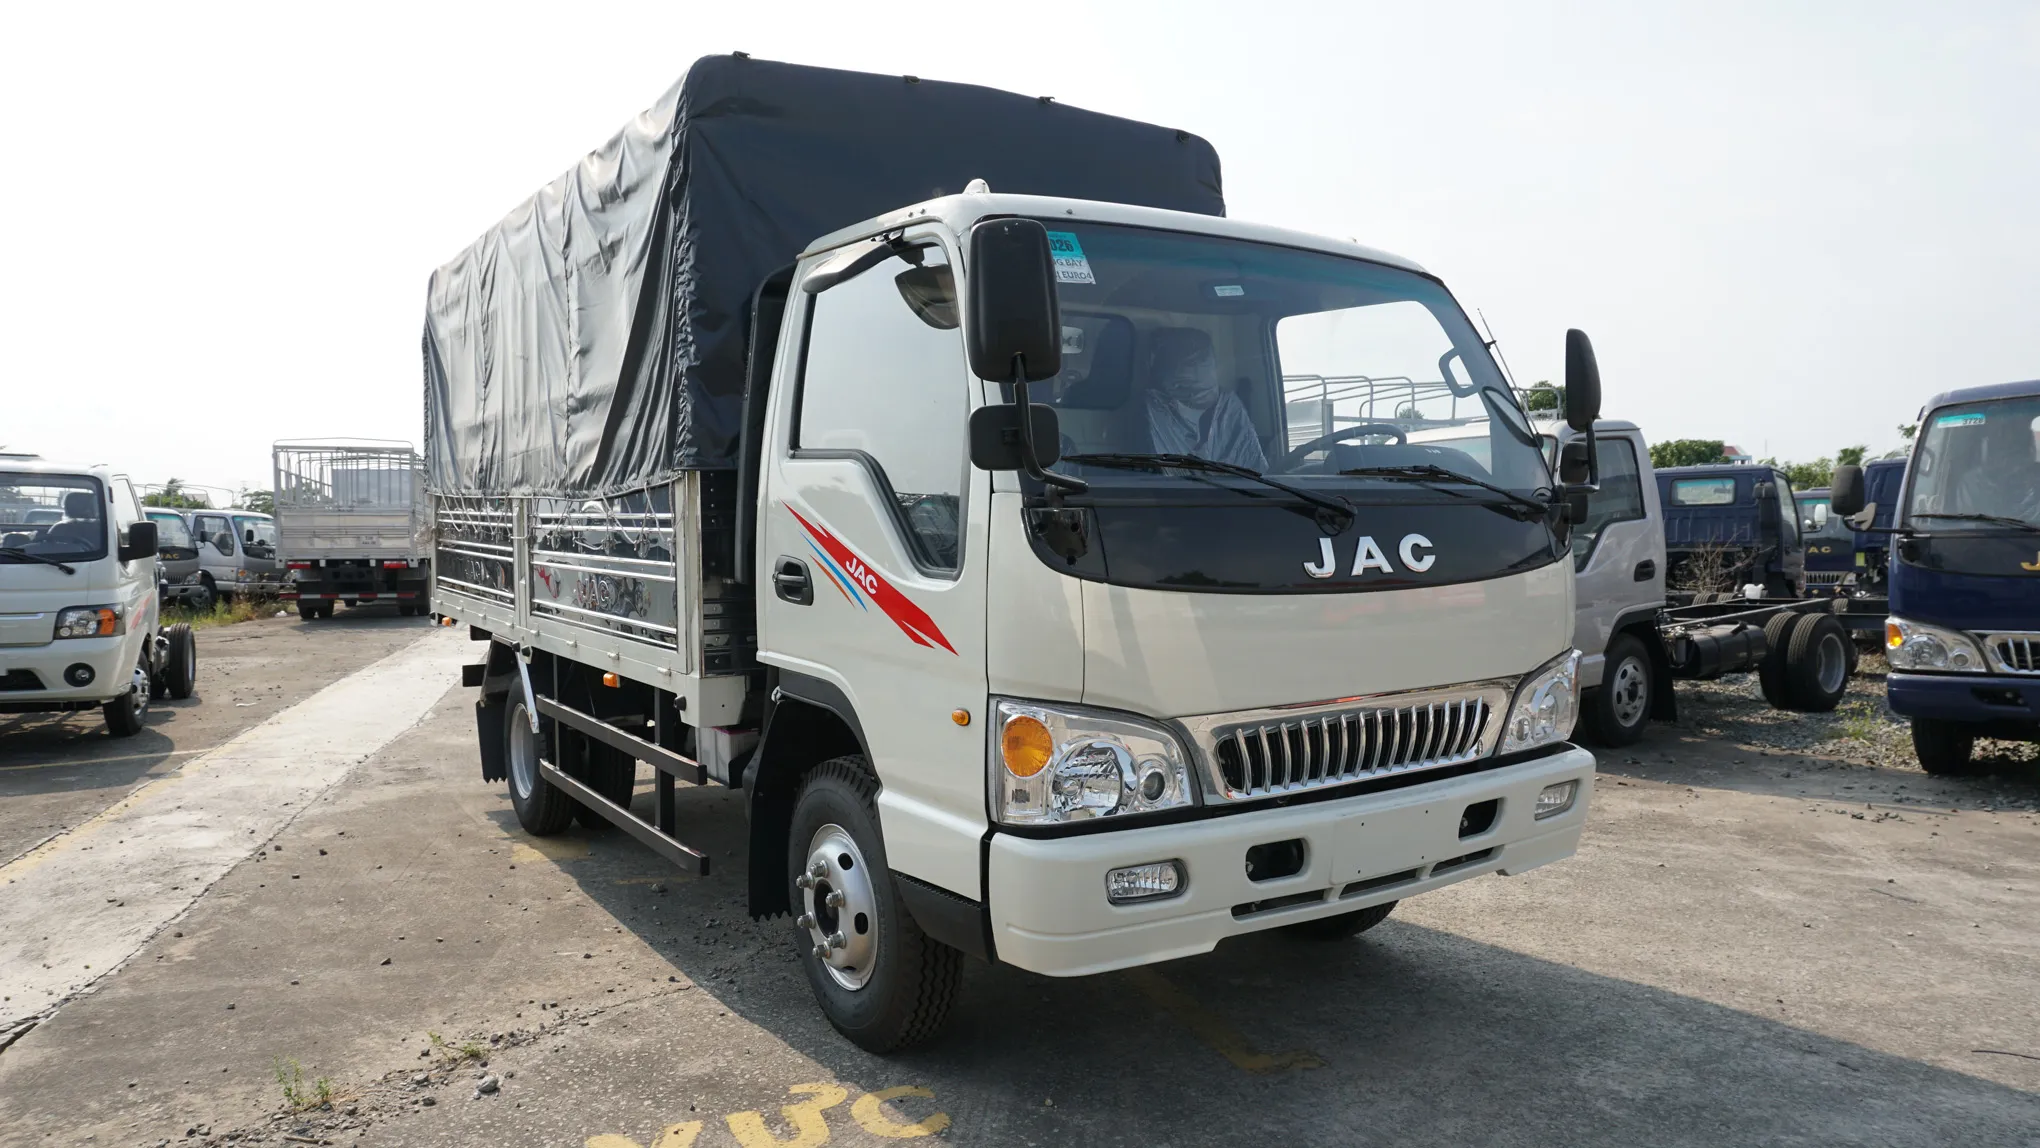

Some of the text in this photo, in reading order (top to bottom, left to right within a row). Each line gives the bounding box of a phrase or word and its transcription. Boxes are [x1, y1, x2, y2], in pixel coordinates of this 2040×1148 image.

[1062, 271, 1092, 280] EURO4
[1303, 533, 1436, 579] JAC
[845, 558, 878, 595] JAC
